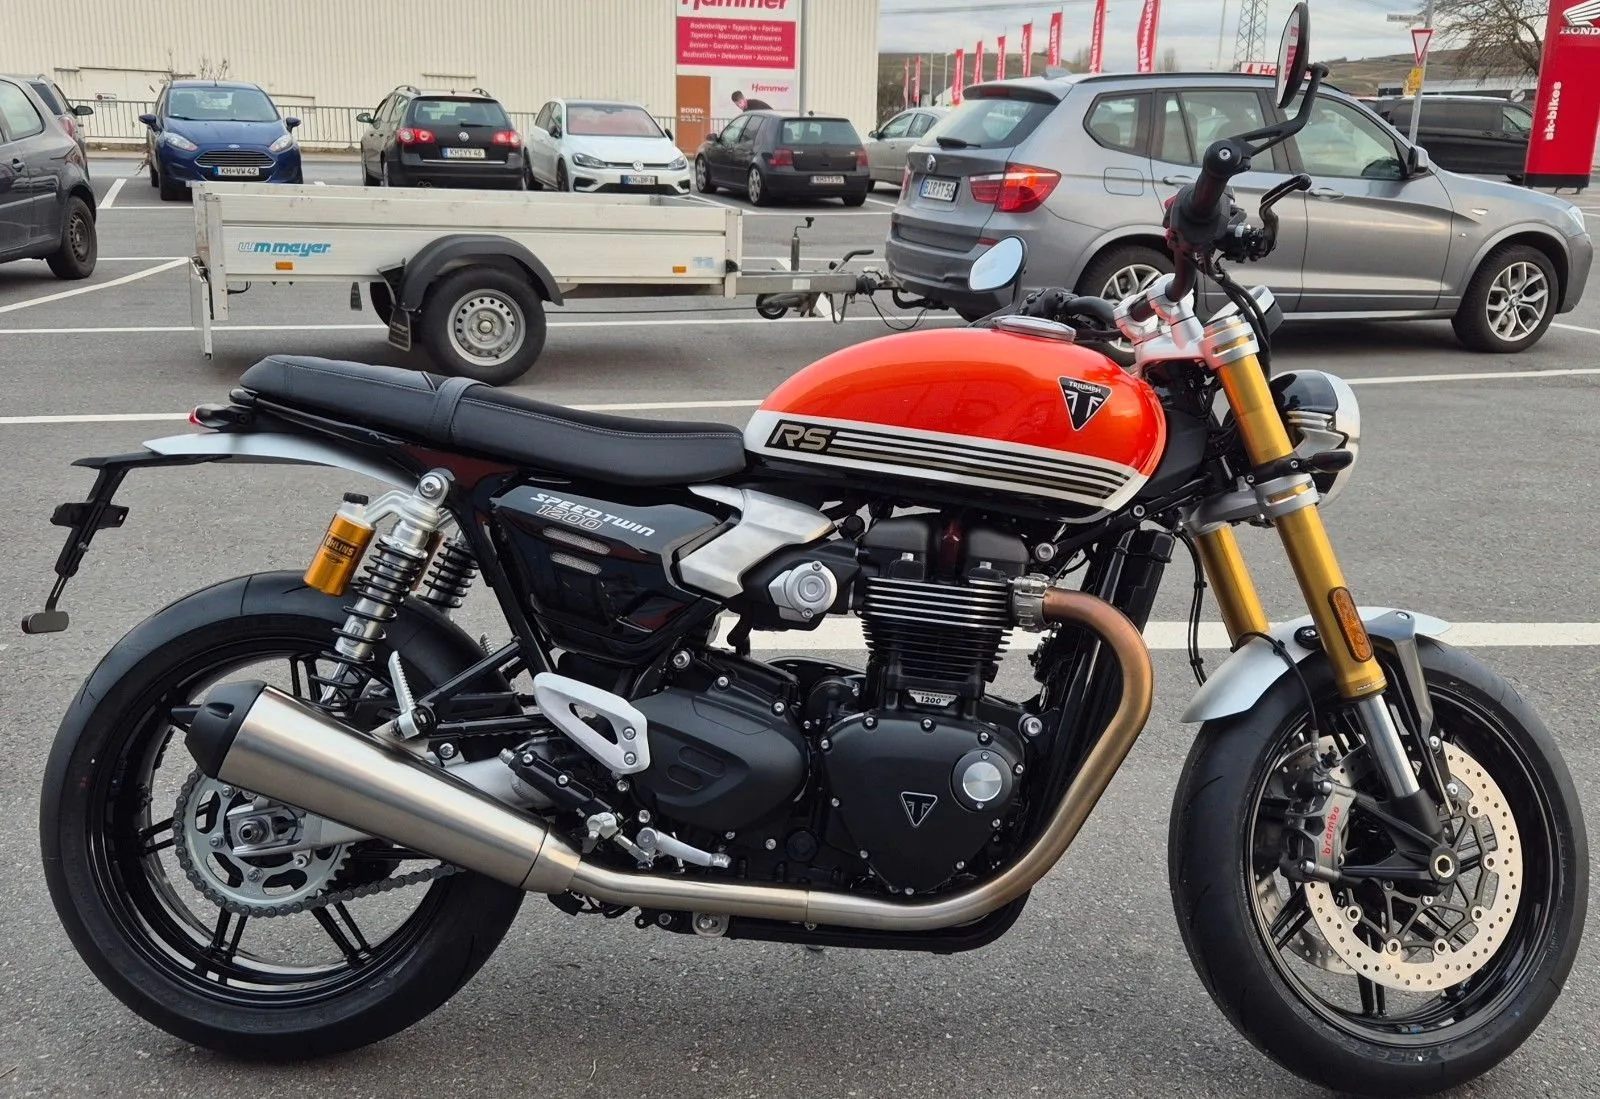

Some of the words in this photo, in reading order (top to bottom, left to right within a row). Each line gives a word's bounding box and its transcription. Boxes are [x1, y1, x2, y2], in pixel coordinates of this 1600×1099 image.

[732, 24, 757, 33] Teppiche
[691, 32, 713, 40] Tapeten
[713, 42, 739, 50] Gardinen
[752, 83, 789, 93] Hammer
[1544, 81, 1562, 141] sk-bikes
[273, 242, 331, 257] meyer
[1069, 381, 1101, 393] TRIUMPH
[771, 423, 832, 451] RS
[530, 493, 602, 518] SPEED
[602, 513, 655, 537] TWIN
[536, 504, 603, 530] 1200
[921, 696, 941, 704] 1200
[1322, 806, 1340, 854] brembo
